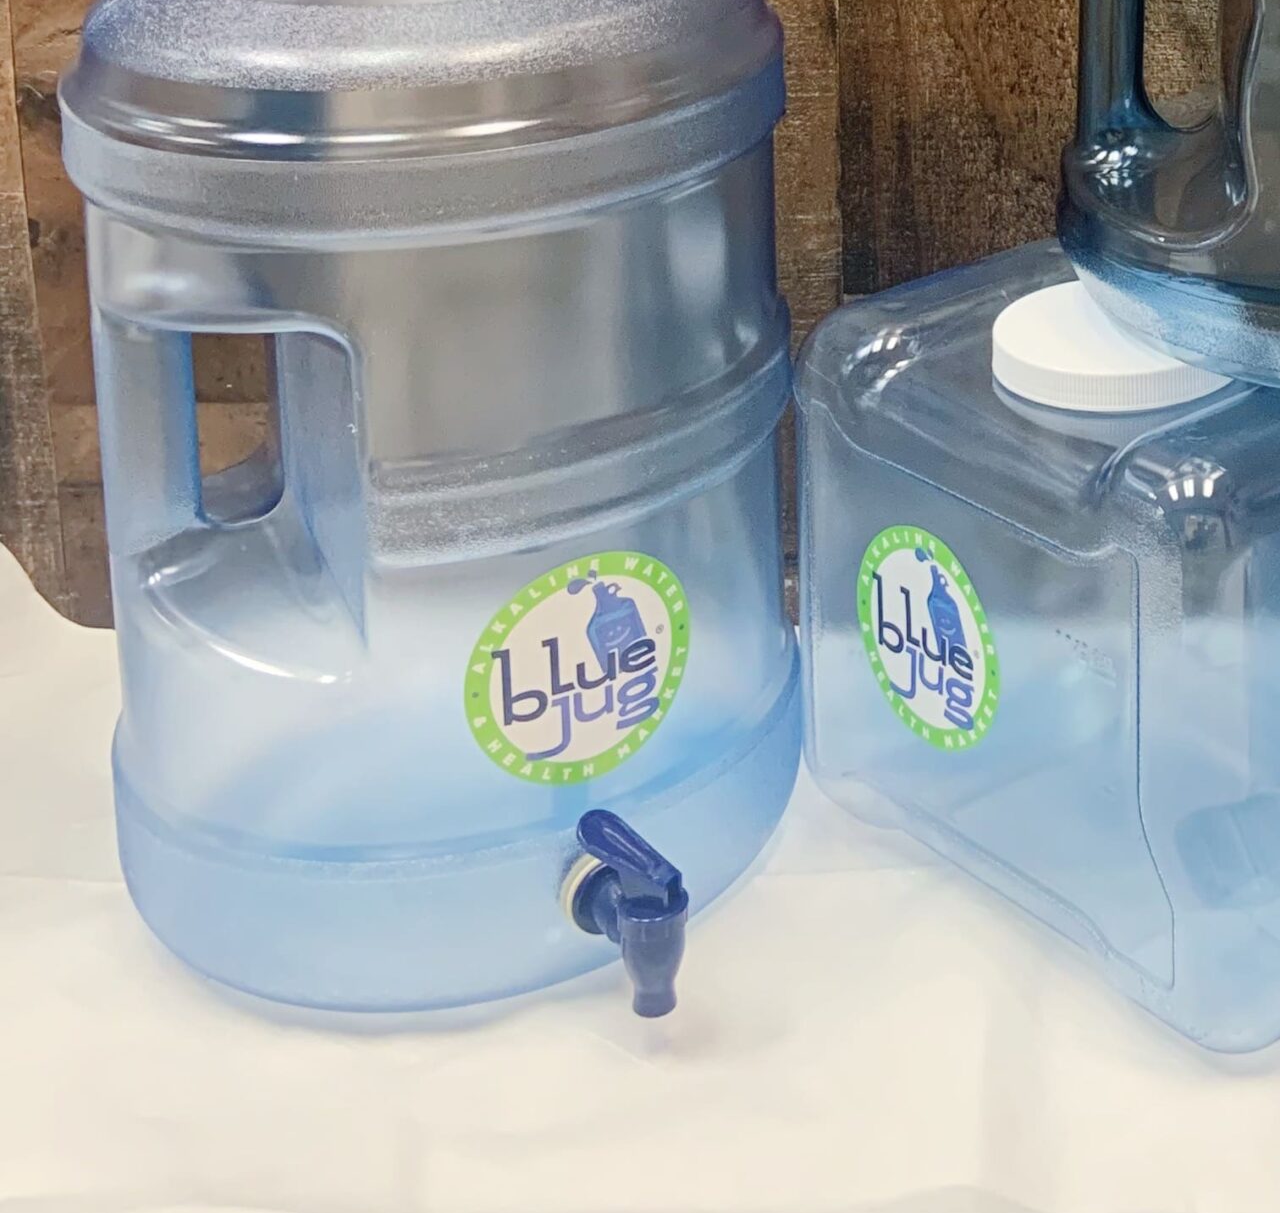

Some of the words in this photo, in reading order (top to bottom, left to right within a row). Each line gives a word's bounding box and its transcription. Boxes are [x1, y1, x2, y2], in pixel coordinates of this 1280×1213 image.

[472, 559, 600, 674] ALKALINE
[625, 557, 683, 613] WATER
[488, 739, 594, 780] HEALTH
[617, 647, 686, 758] MARKET
